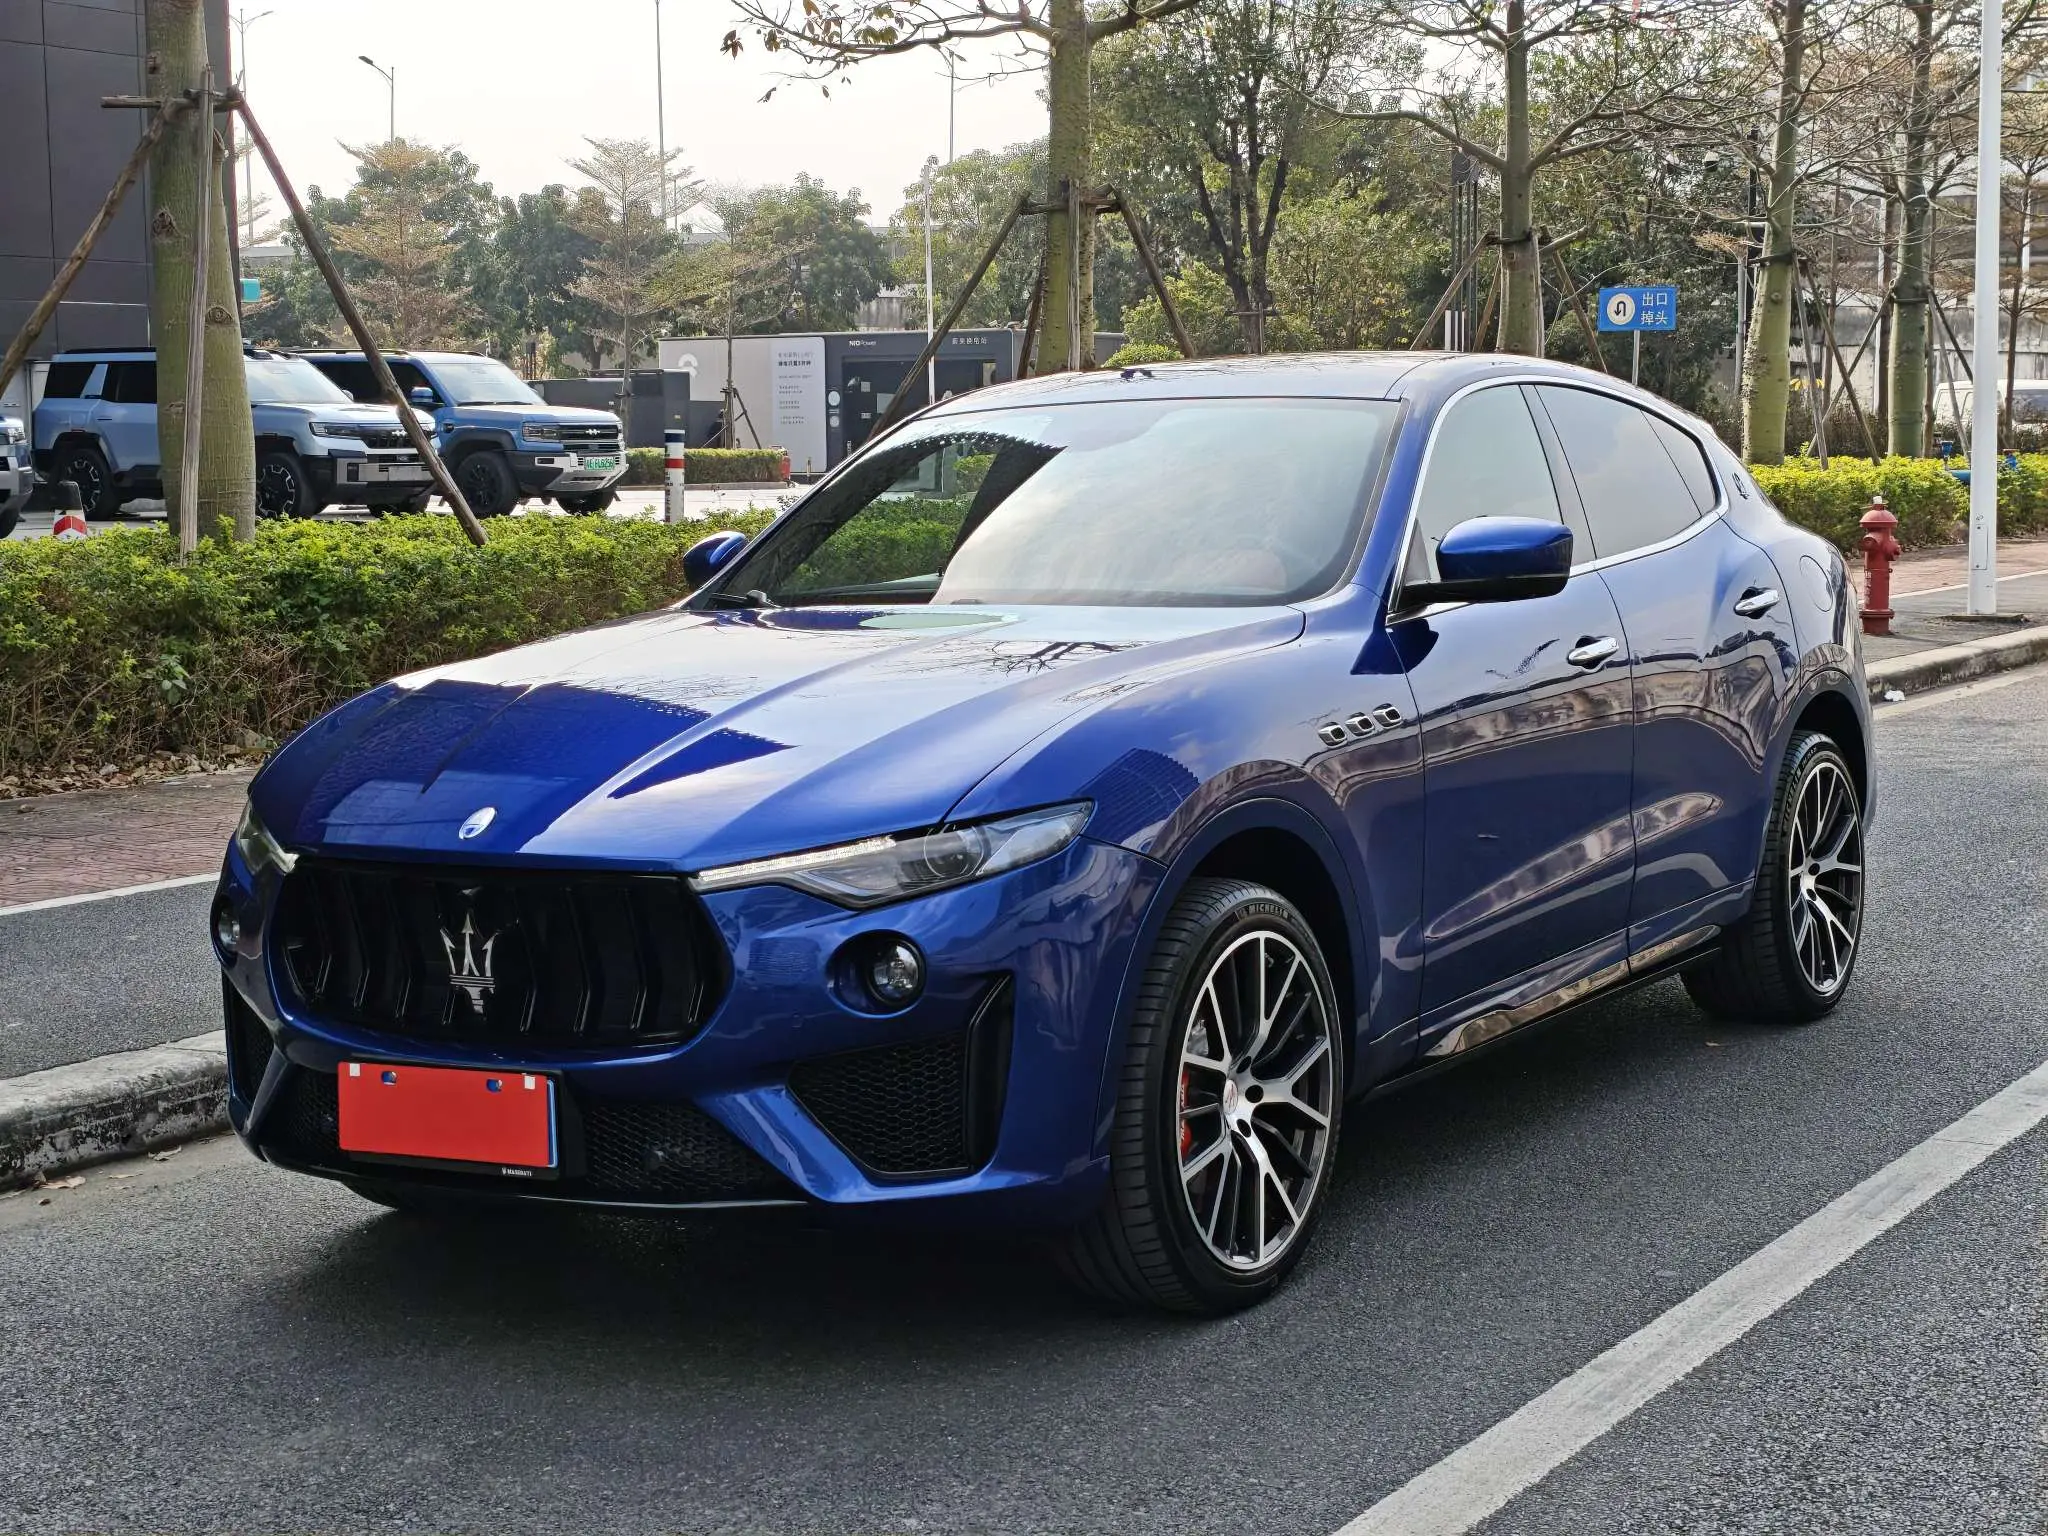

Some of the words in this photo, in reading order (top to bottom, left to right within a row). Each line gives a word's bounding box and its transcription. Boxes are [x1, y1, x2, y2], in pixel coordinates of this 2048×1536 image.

[1642, 291, 1668, 306] 出口
[1641, 310, 1669, 325] 掉头
[1248, 903, 1289, 919] MICHELIN
[507, 1168, 531, 1176] MASERATI
